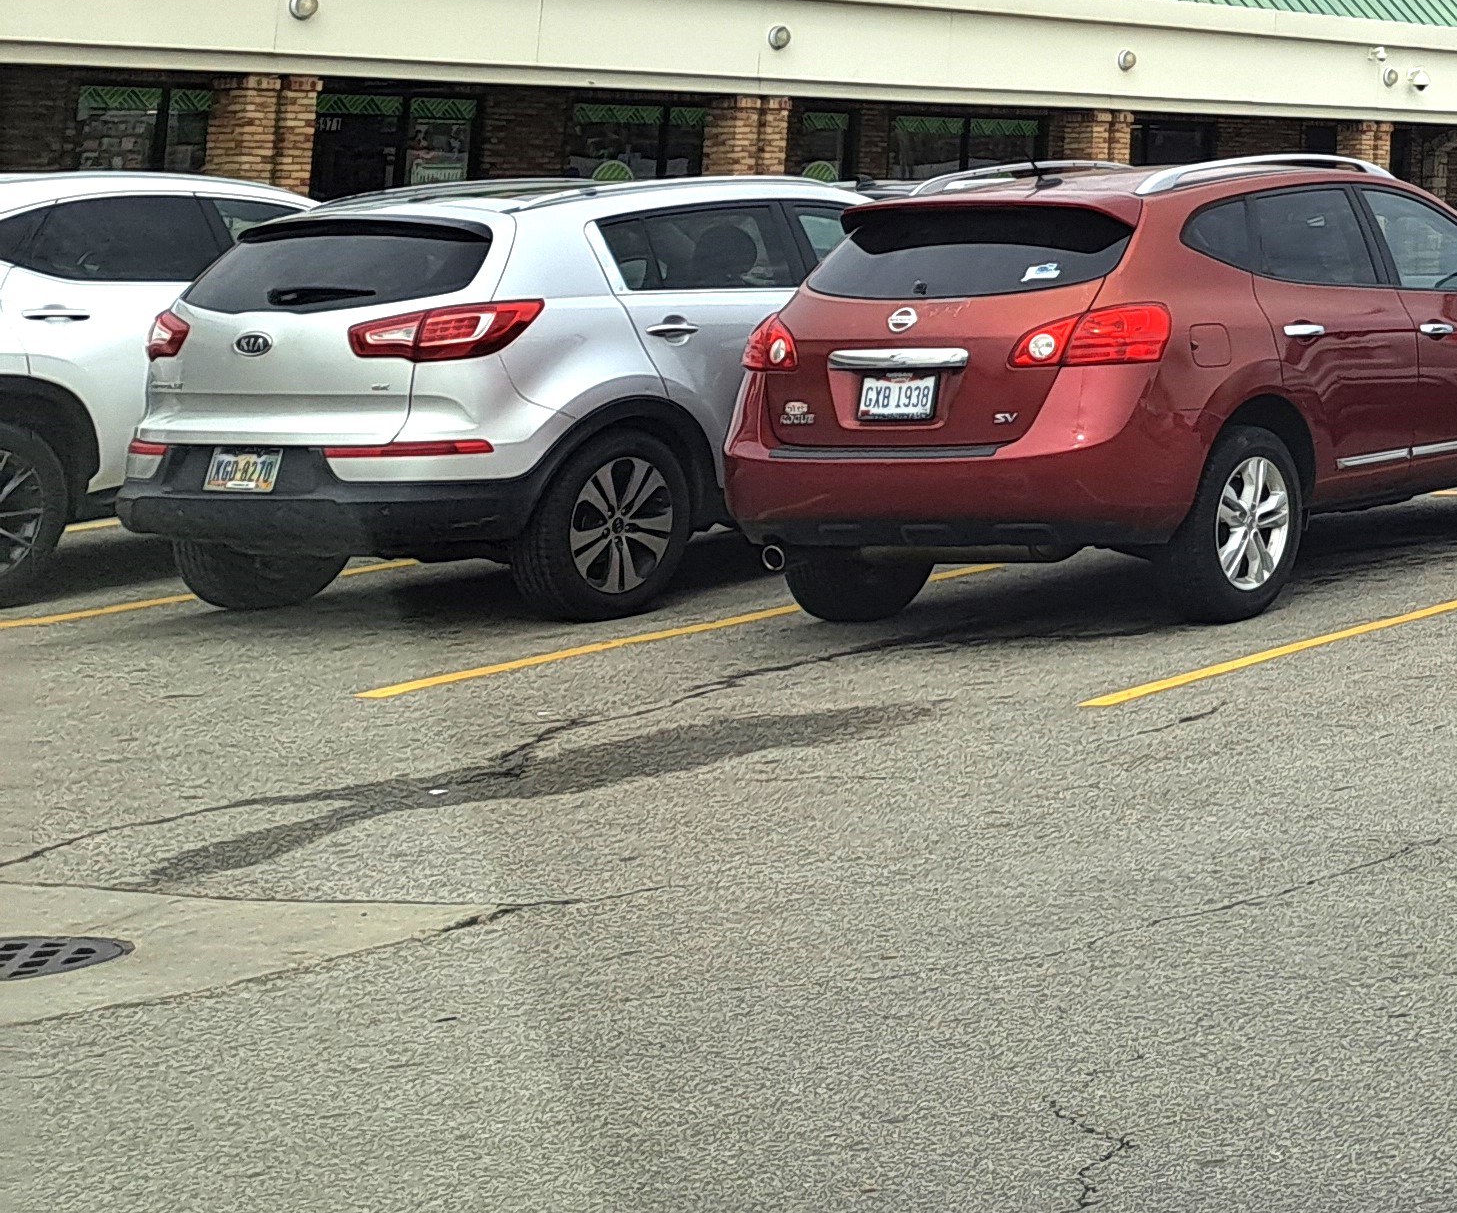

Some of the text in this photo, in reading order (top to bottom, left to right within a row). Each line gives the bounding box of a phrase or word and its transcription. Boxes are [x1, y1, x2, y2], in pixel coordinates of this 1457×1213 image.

[238, 336, 268, 352] KIA
[863, 384, 931, 409] GXB 1938
[993, 413, 1018, 423] SV
